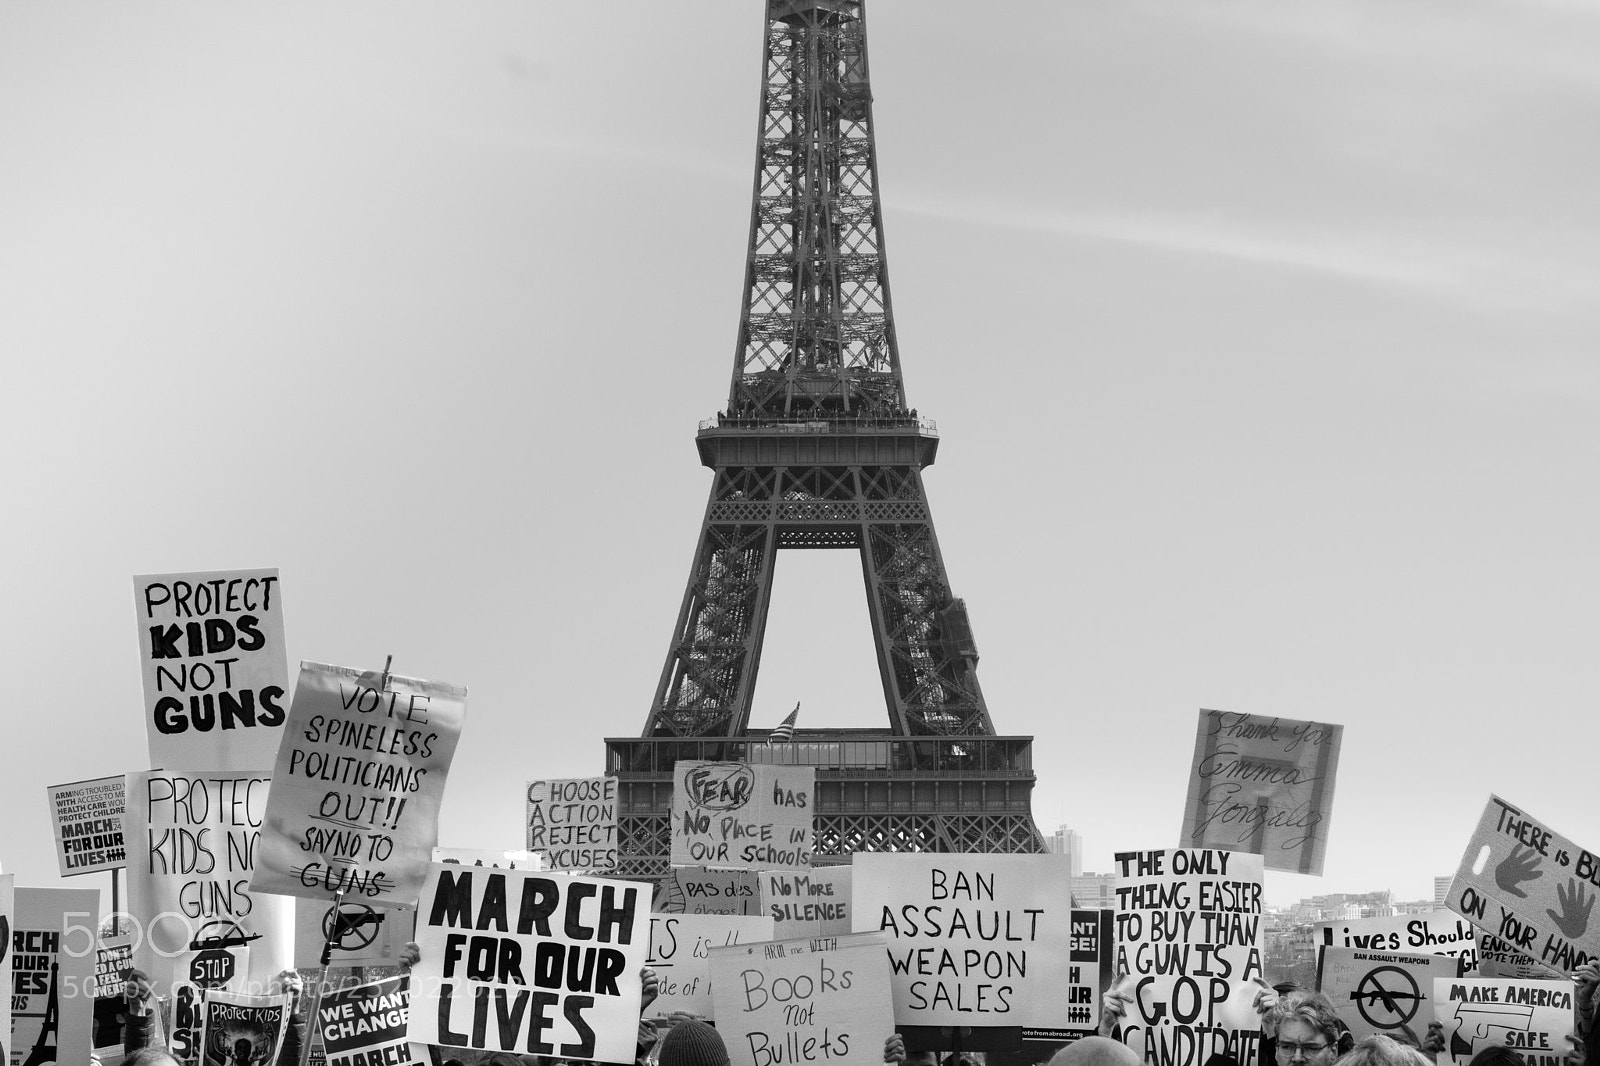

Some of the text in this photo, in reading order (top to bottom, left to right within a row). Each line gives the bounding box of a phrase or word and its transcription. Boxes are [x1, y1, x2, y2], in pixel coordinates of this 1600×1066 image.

[145, 576, 278, 618] PROTECT
[149, 615, 266, 659] KIDS
[156, 658, 240, 692] NOT
[154, 685, 286, 734] GUNS
[339, 683, 431, 724] VOTE
[304, 715, 438, 758] SPINELESS
[289, 749, 427, 792] POLITICIANS
[55, 789, 84, 800] ARMING
[85, 783, 121, 795] TROUBLED
[56, 799, 76, 807] WITH
[77, 795, 103, 804] ACCESS
[148, 778, 271, 827] PROTEC
[528, 780, 616, 803] CHOOSE
[692, 771, 750, 804] FEAR
[58, 804, 86, 815] HEALTH
[87, 801, 107, 811] CARE
[59, 812, 92, 823] PROTECT
[529, 804, 613, 826] ACTION
[61, 818, 113, 838] MARCH
[63, 832, 124, 854] FOR OUR
[532, 824, 616, 846] REJECT
[790, 828, 806, 844] IN
[1493, 798, 1552, 857] THERE
[1555, 850, 1570, 866] IS
[66, 850, 106, 869] LIVES
[149, 828, 215, 875] KIDS
[368, 833, 394, 862] TO
[690, 842, 729, 862] OUR
[1115, 850, 1230, 877] THE ONLY
[299, 862, 386, 897] GUNS
[686, 882, 720, 897] PAS
[932, 868, 994, 901] BAN
[179, 879, 252, 918] GUNS
[428, 870, 638, 945] MARCH
[771, 903, 846, 922] SILENCE
[1115, 881, 1262, 914] THING EASIER
[880, 904, 1044, 941] ASSAULT
[1116, 911, 1259, 946] TO BUY THAN
[1407, 920, 1474, 947] Should
[1460, 887, 1487, 920] ON
[1499, 906, 1537, 950] YOUR
[809, 938, 837, 953] WITH
[1353, 953, 1430, 965] BAN ASSAULT WEAPONS
[1481, 951, 1534, 965] VOTE THEM
[195, 957, 230, 979] STOP
[443, 933, 626, 996] FOR OUR
[887, 947, 1026, 979] WEAPON
[1117, 943, 1263, 981] A GUN IS A
[909, 981, 1013, 1013] SALES
[1449, 984, 1571, 1010] MAKE AMERICA
[255, 1009, 281, 1023] KIDS
[320, 1003, 355, 1022] WE
[438, 983, 596, 1059] LIVES
[746, 1027, 849, 1066] Bullets
[1505, 1031, 1549, 1048] SAFE
